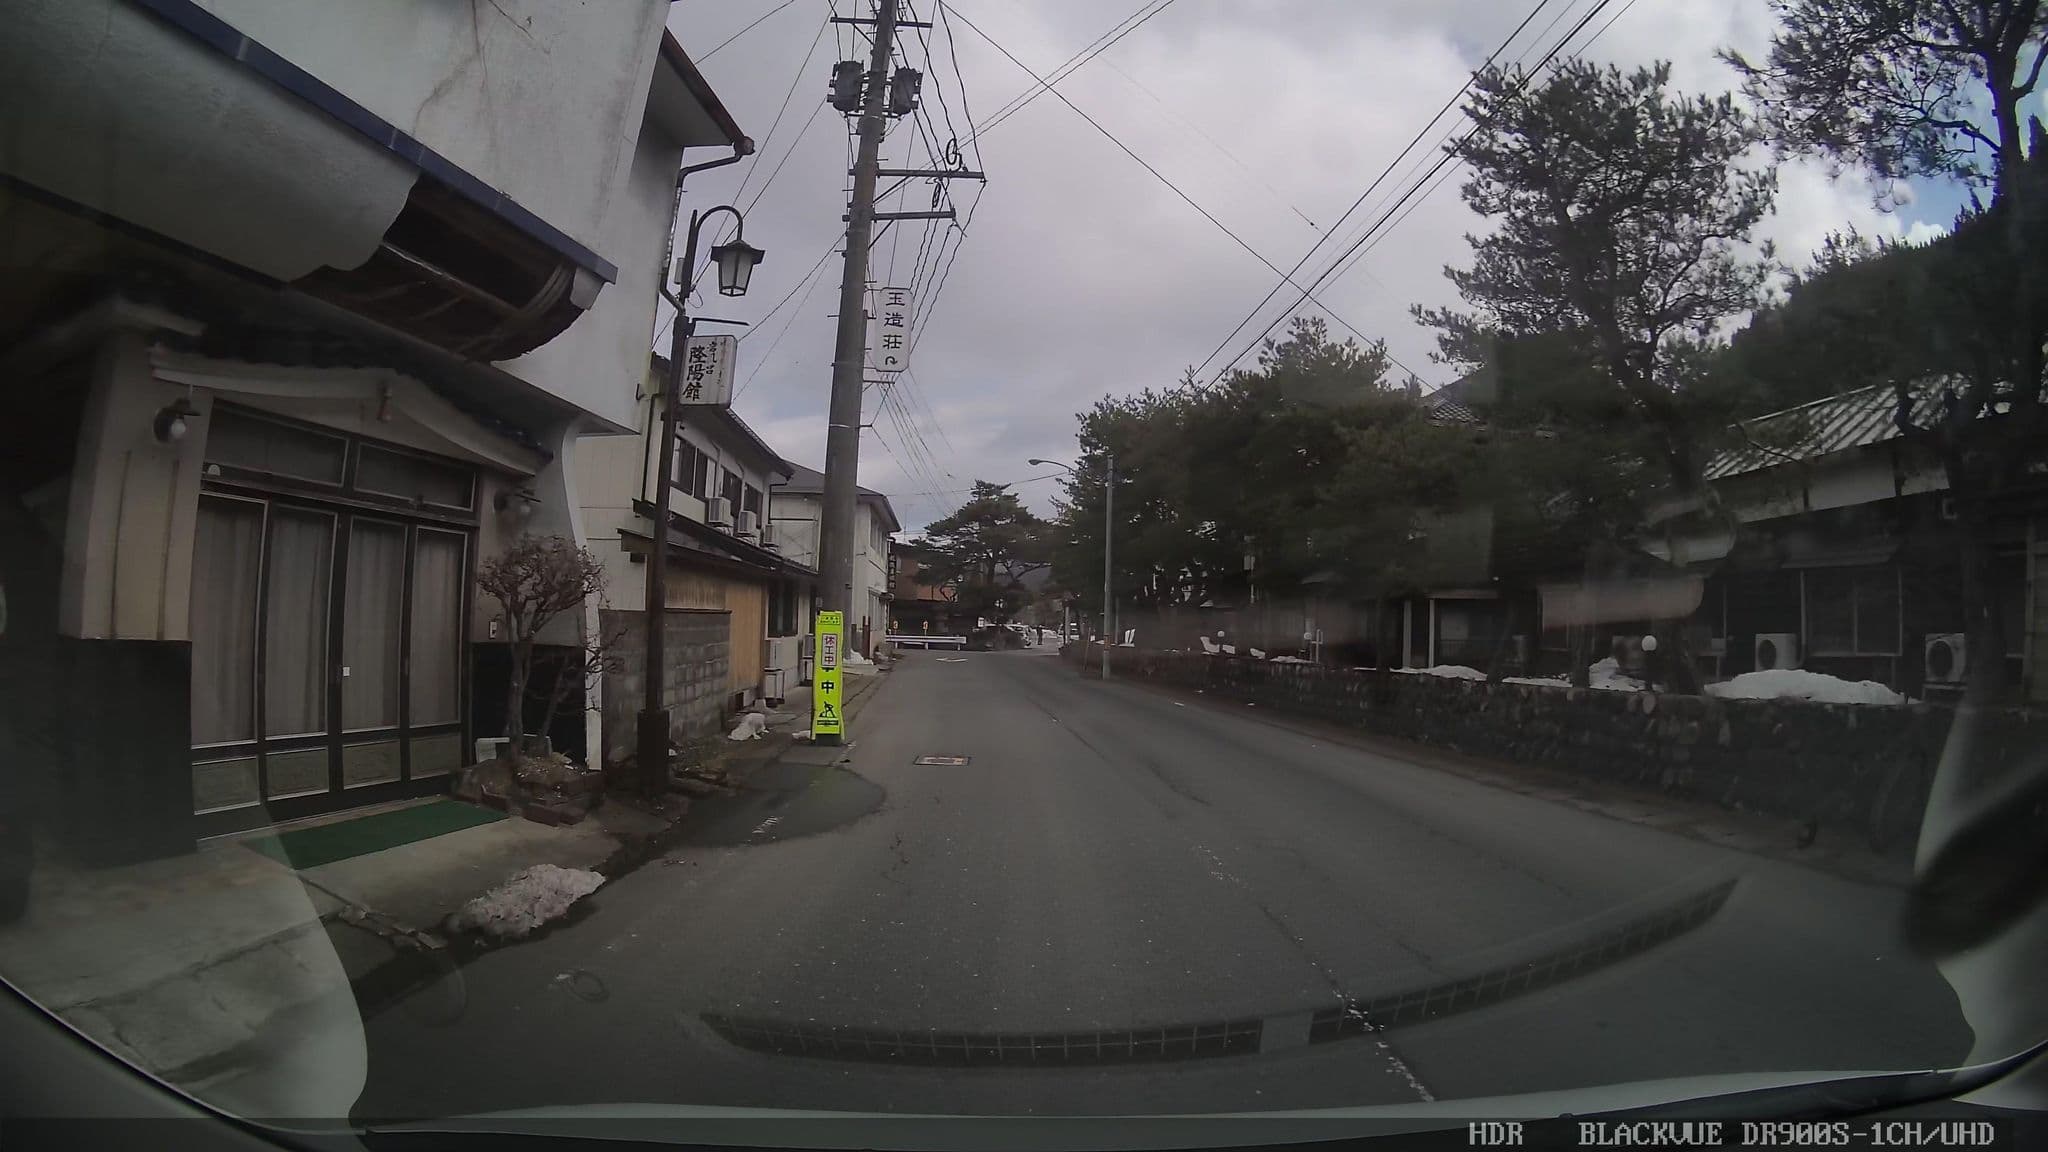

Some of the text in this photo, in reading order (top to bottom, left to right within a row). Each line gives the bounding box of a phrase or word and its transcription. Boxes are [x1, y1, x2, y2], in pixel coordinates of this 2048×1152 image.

[883, 292, 905, 350] 玉造荘
[825, 636, 835, 665] 休工中
